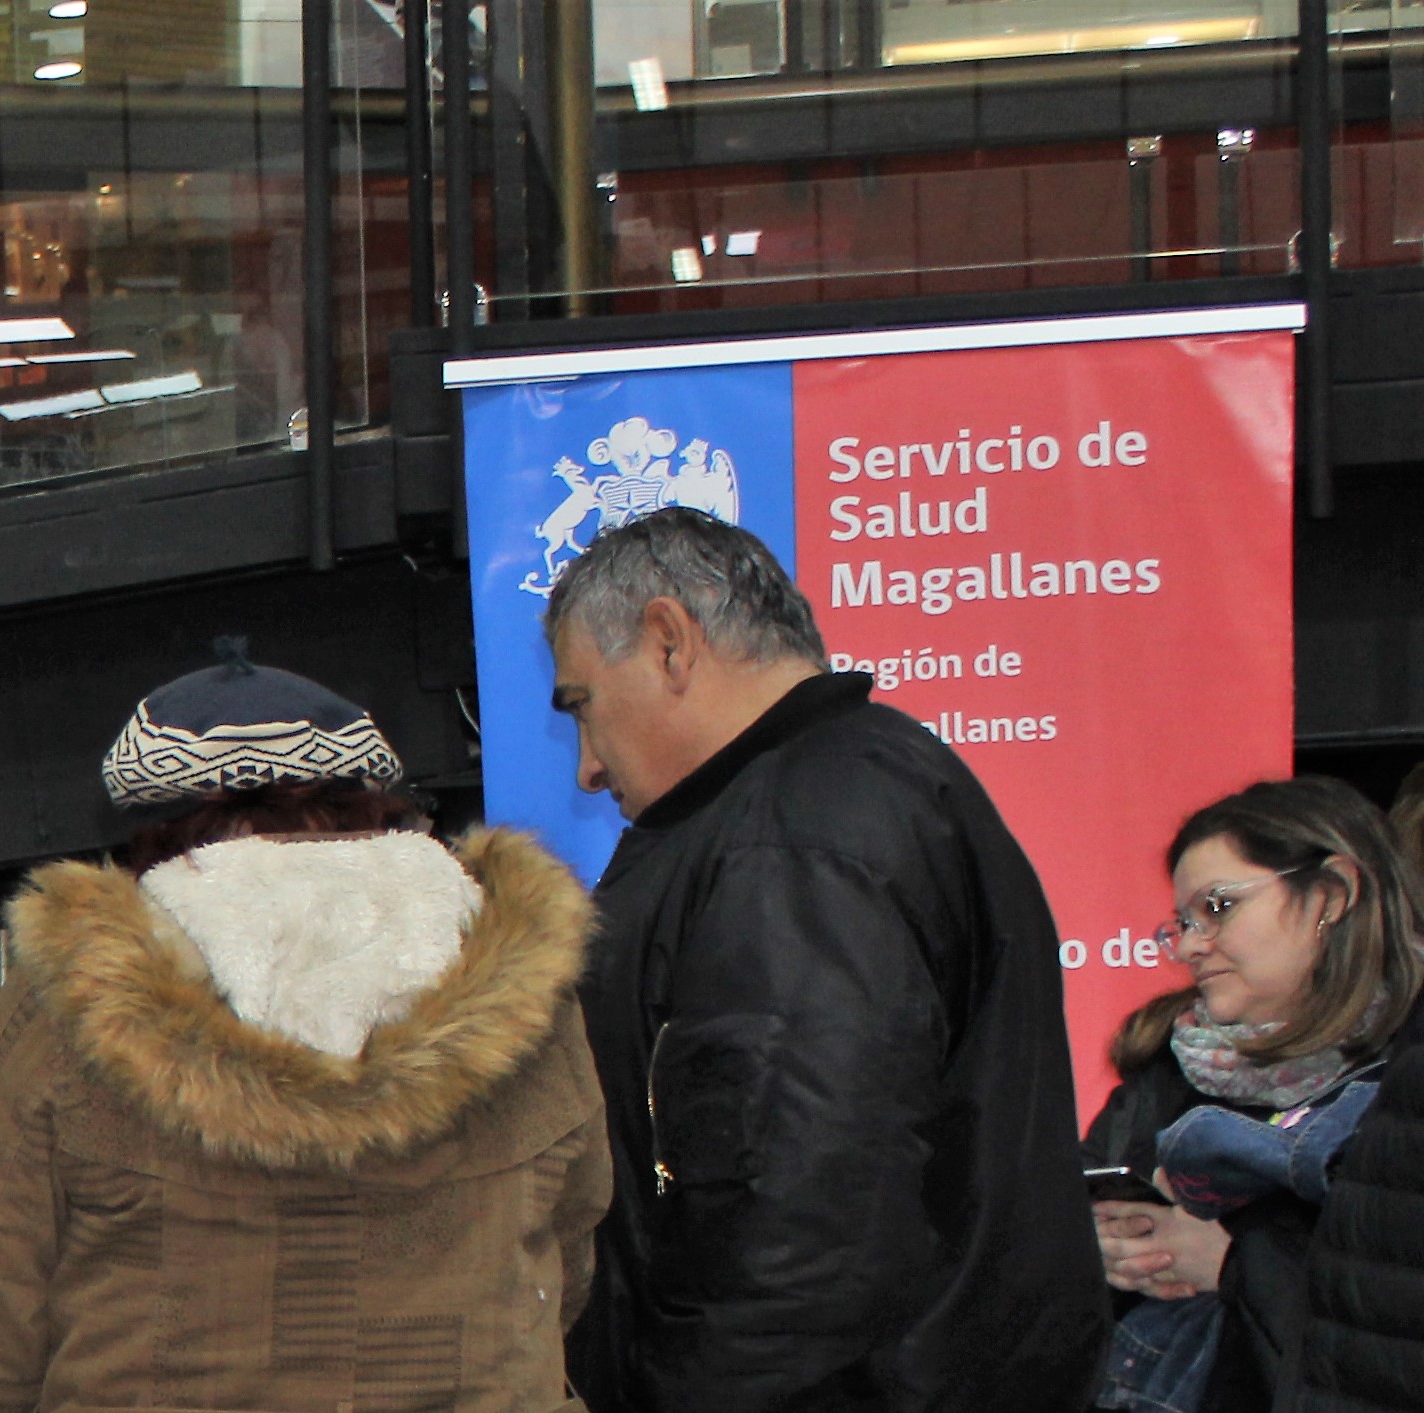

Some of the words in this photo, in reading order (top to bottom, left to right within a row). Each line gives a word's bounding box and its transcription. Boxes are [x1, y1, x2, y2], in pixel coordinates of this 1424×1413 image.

[828, 425, 1061, 484] Servicio
[1077, 420, 1149, 468] de
[828, 486, 989, 542] Salud
[830, 552, 1162, 616] Magallanes
[972, 644, 1023, 678] de
[1101, 927, 1161, 968] de
